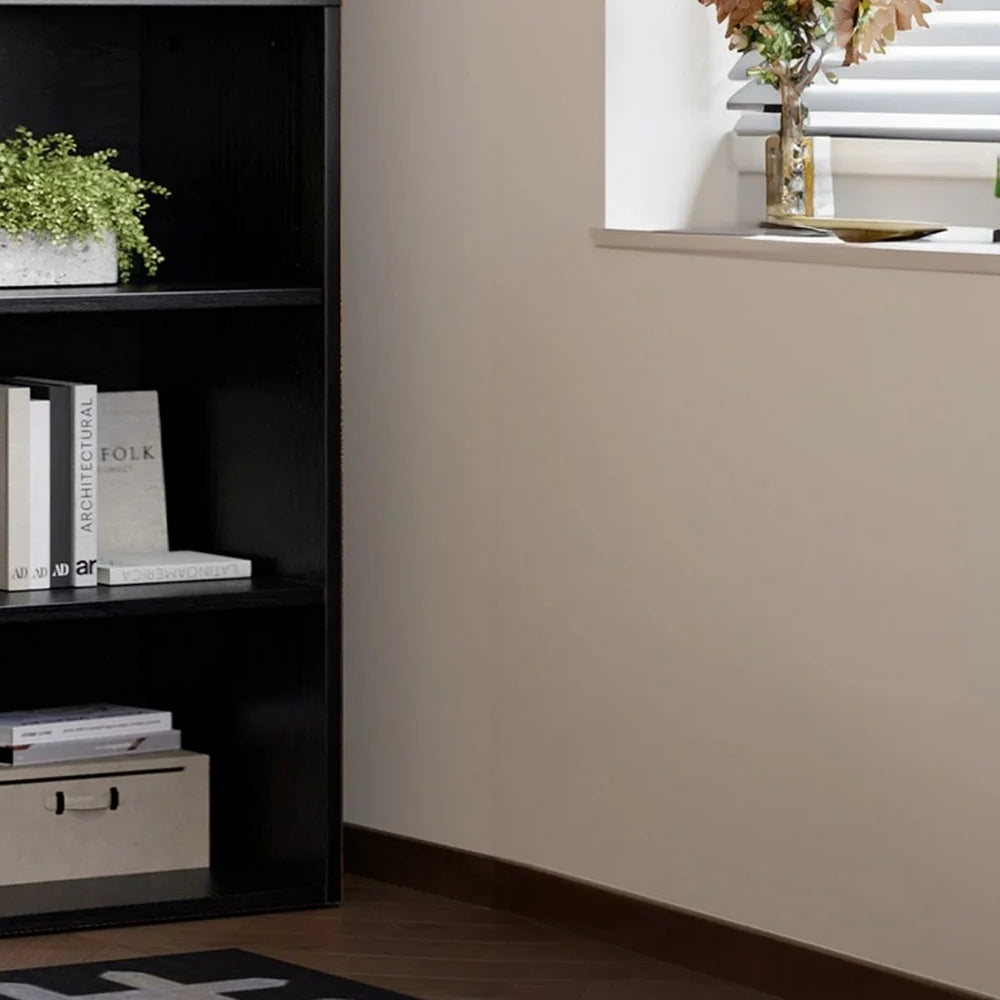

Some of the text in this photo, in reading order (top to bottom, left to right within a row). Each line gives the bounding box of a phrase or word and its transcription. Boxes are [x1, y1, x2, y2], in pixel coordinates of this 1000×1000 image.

[101, 445, 155, 462] FOLK
[80, 397, 93, 533] ARCHITECTURAL
[12, 566, 28, 579] AD
[32, 566, 48, 579] AD
[52, 563, 70, 578] AD
[76, 559, 97, 575] ar
[121, 563, 239, 583] LATINOAMERICA
